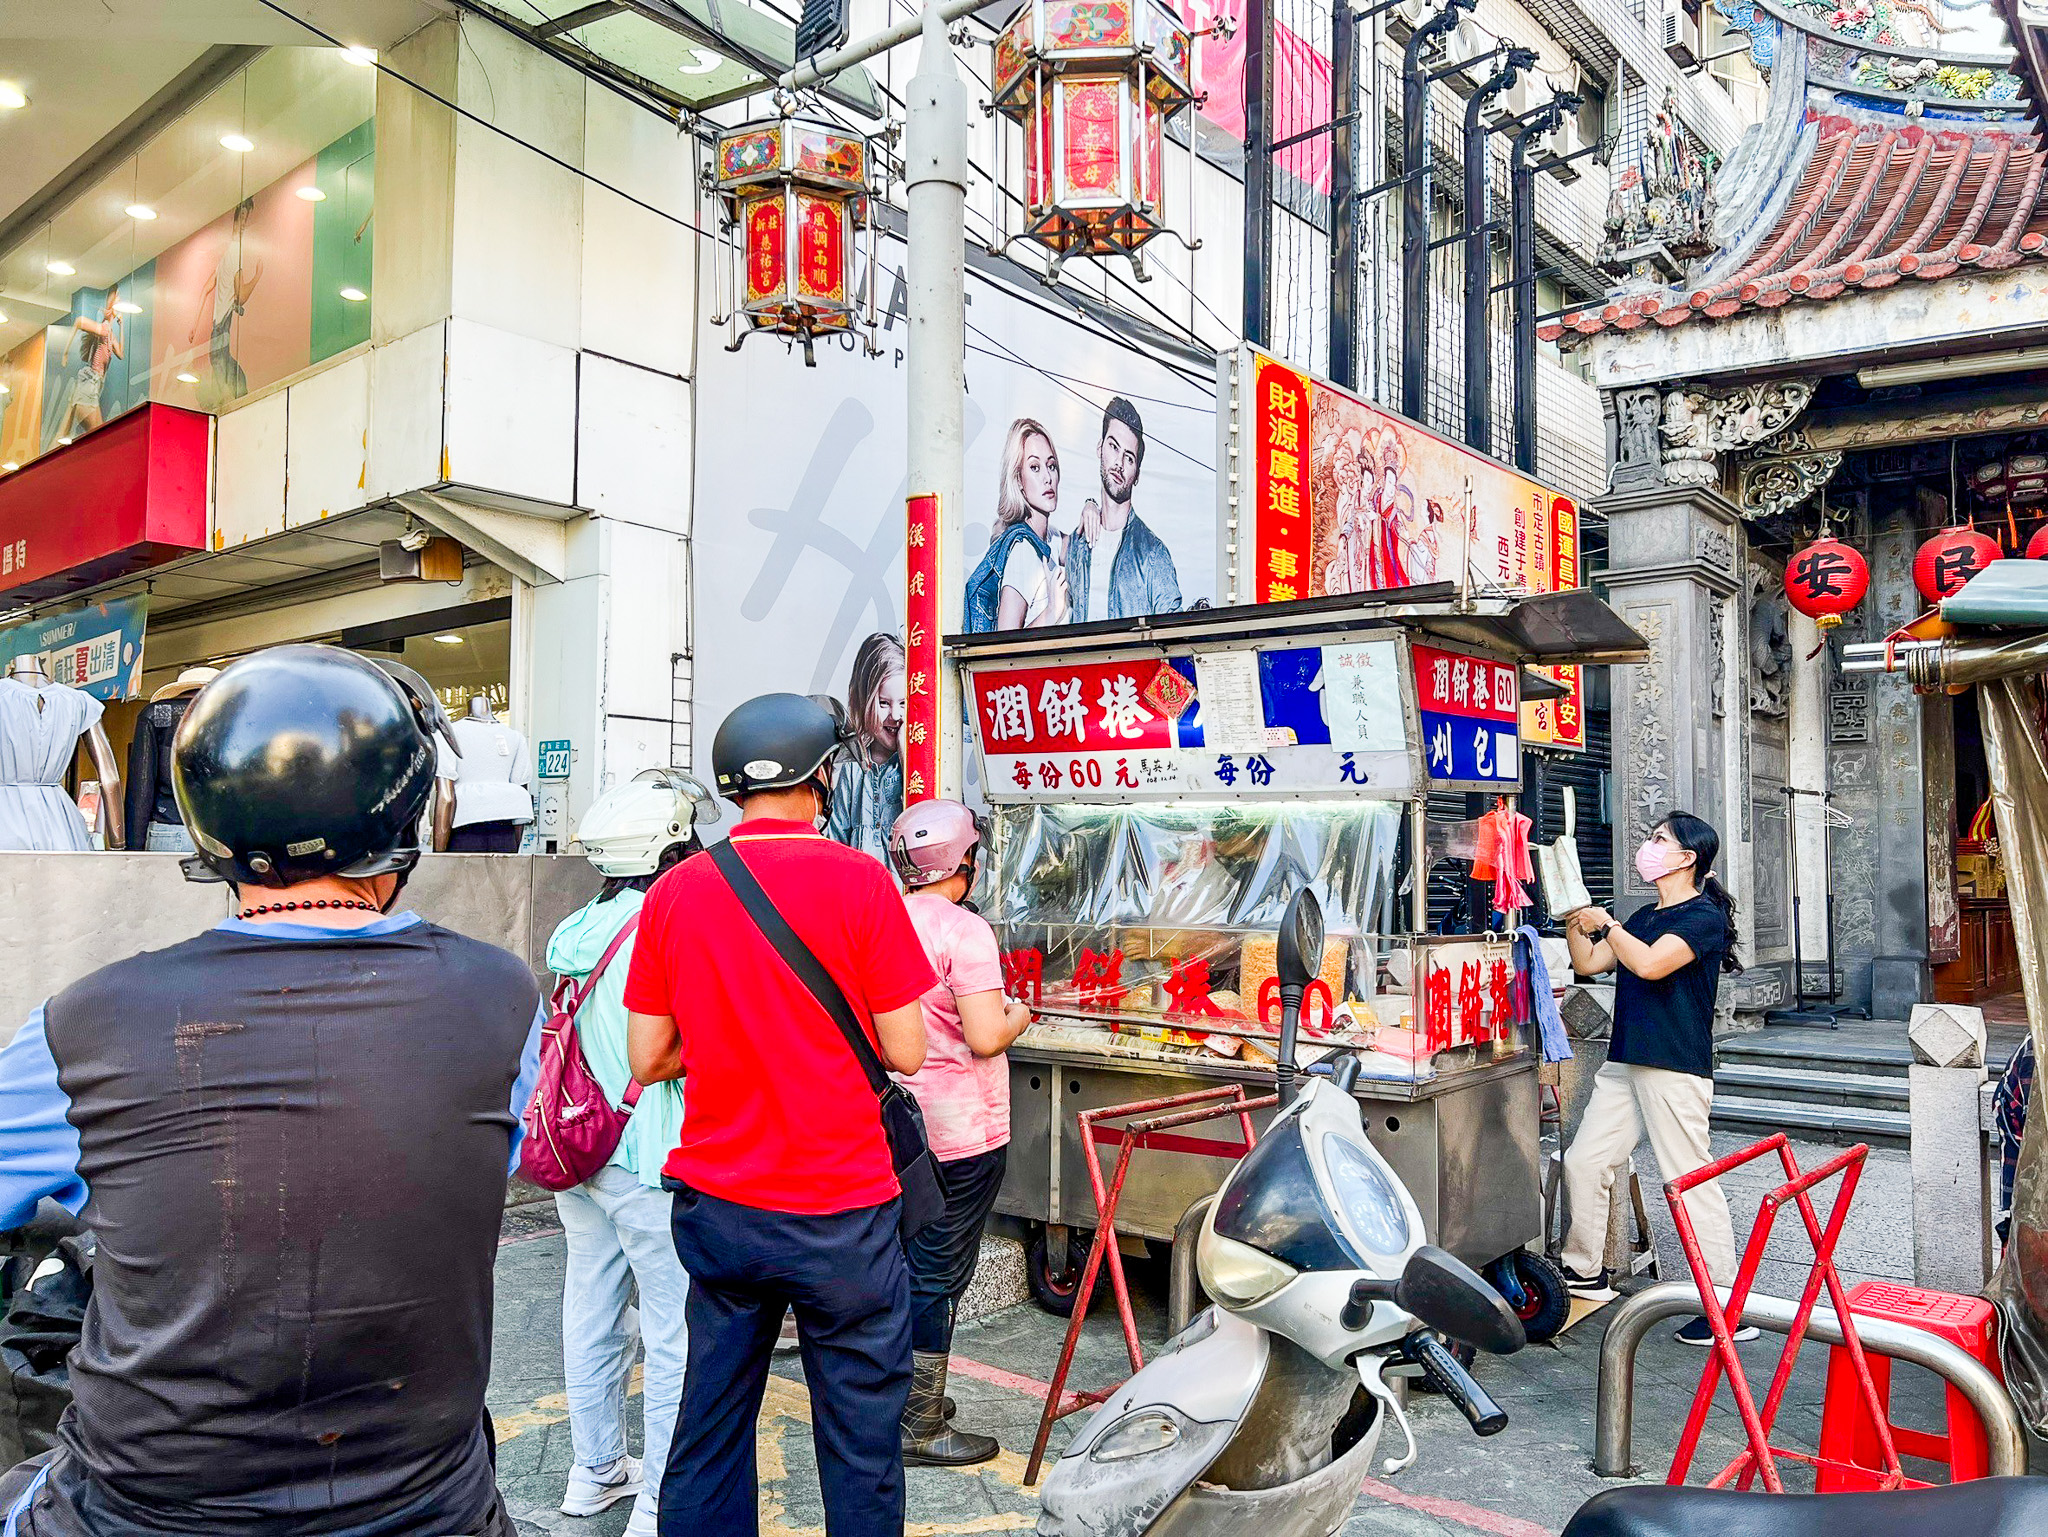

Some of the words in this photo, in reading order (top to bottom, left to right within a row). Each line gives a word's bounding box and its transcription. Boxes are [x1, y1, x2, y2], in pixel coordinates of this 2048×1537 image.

[813, 211, 829, 287] 風調雨順
[1793, 552, 1852, 598] 安
[986, 673, 1155, 744] 潤餅捲
[1351, 674, 1369, 740] 兼職人員
[1432, 658, 1490, 710] 潤餅捲
[1497, 673, 1513, 706] 60
[547, 753, 568, 773] 224
[1214, 754, 1276, 786] 每份
[1339, 752, 1369, 785] 元
[1432, 721, 1494, 777] 刈包
[1257, 976, 1334, 1039] 60
